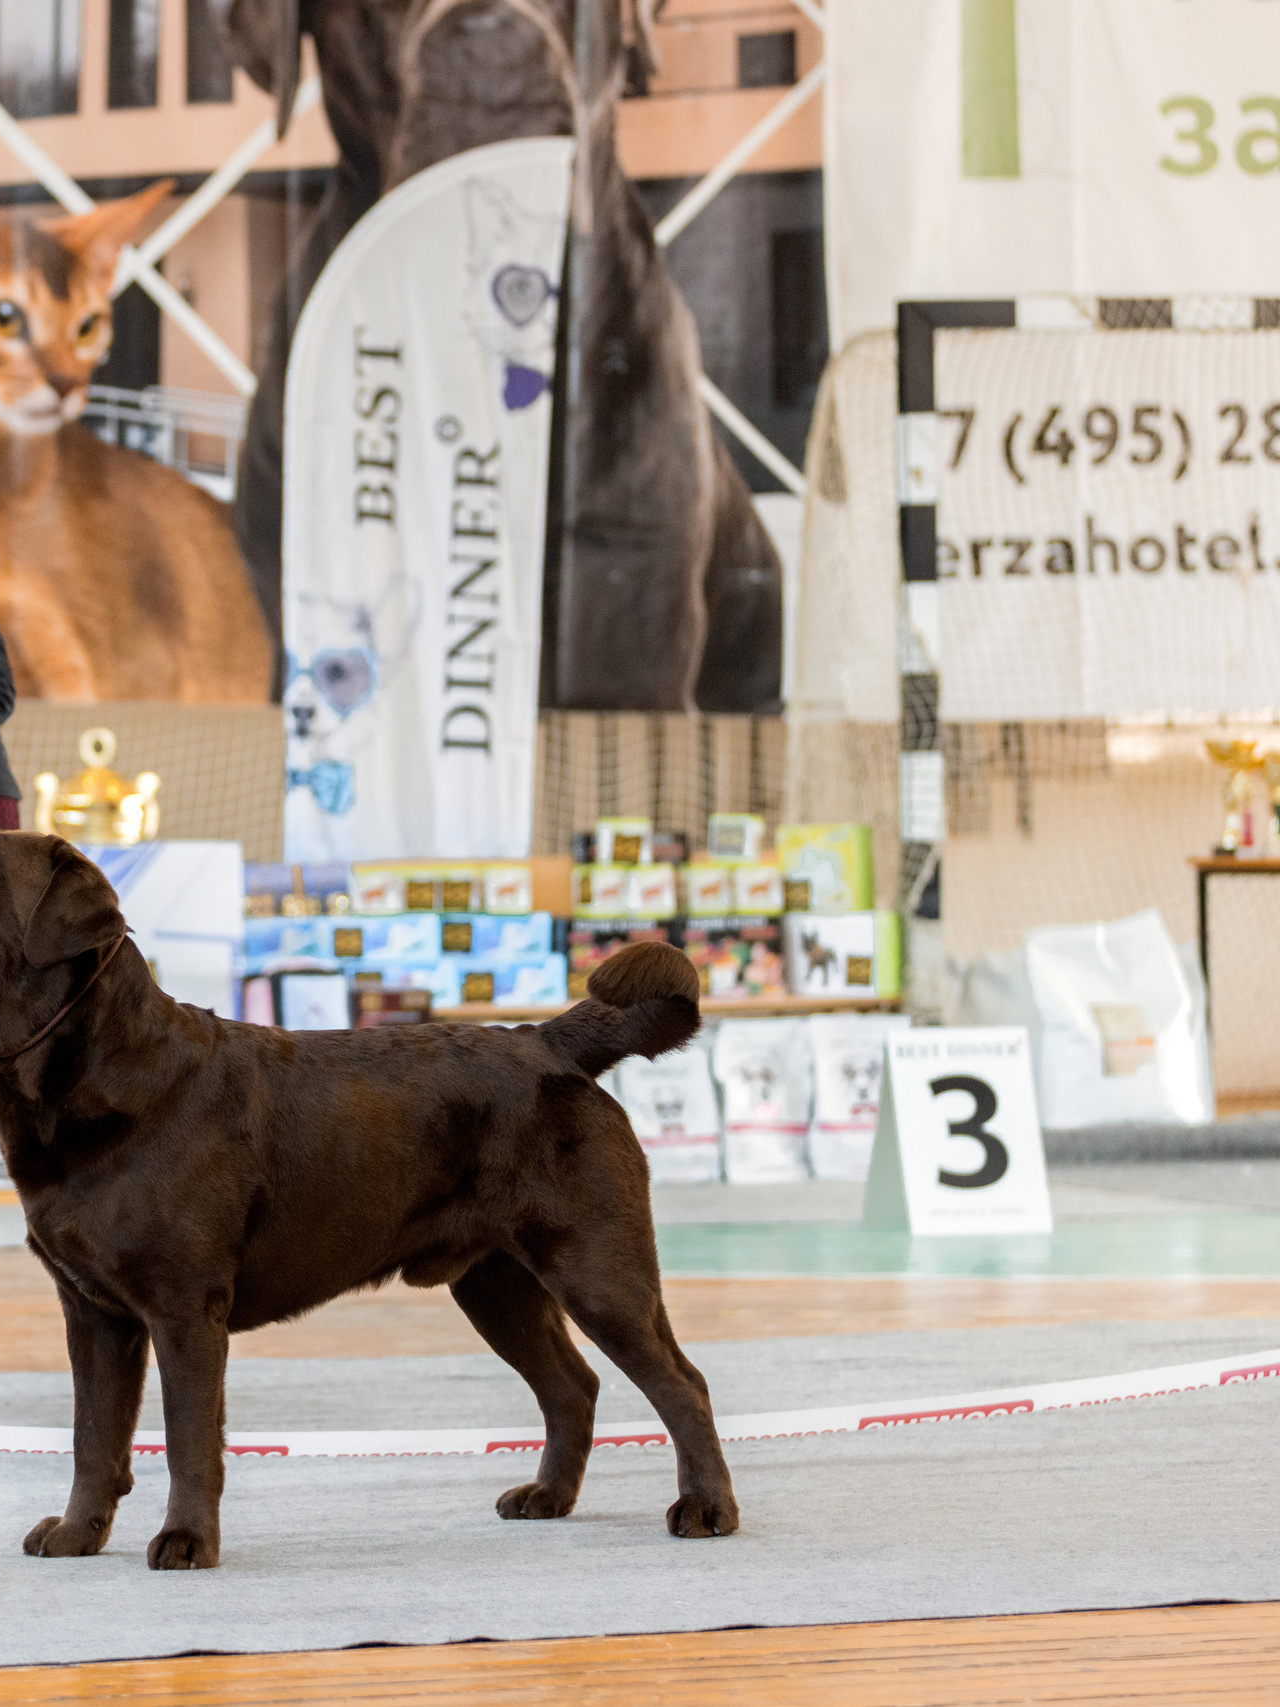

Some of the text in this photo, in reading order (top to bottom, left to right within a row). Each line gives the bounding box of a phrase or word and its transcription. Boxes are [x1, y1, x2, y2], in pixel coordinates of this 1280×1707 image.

[353, 324, 403, 526] BEST
[1005, 404, 1188, 484] (495)
[441, 438, 502, 756] DINNER
[928, 1073, 1010, 1189] 3
